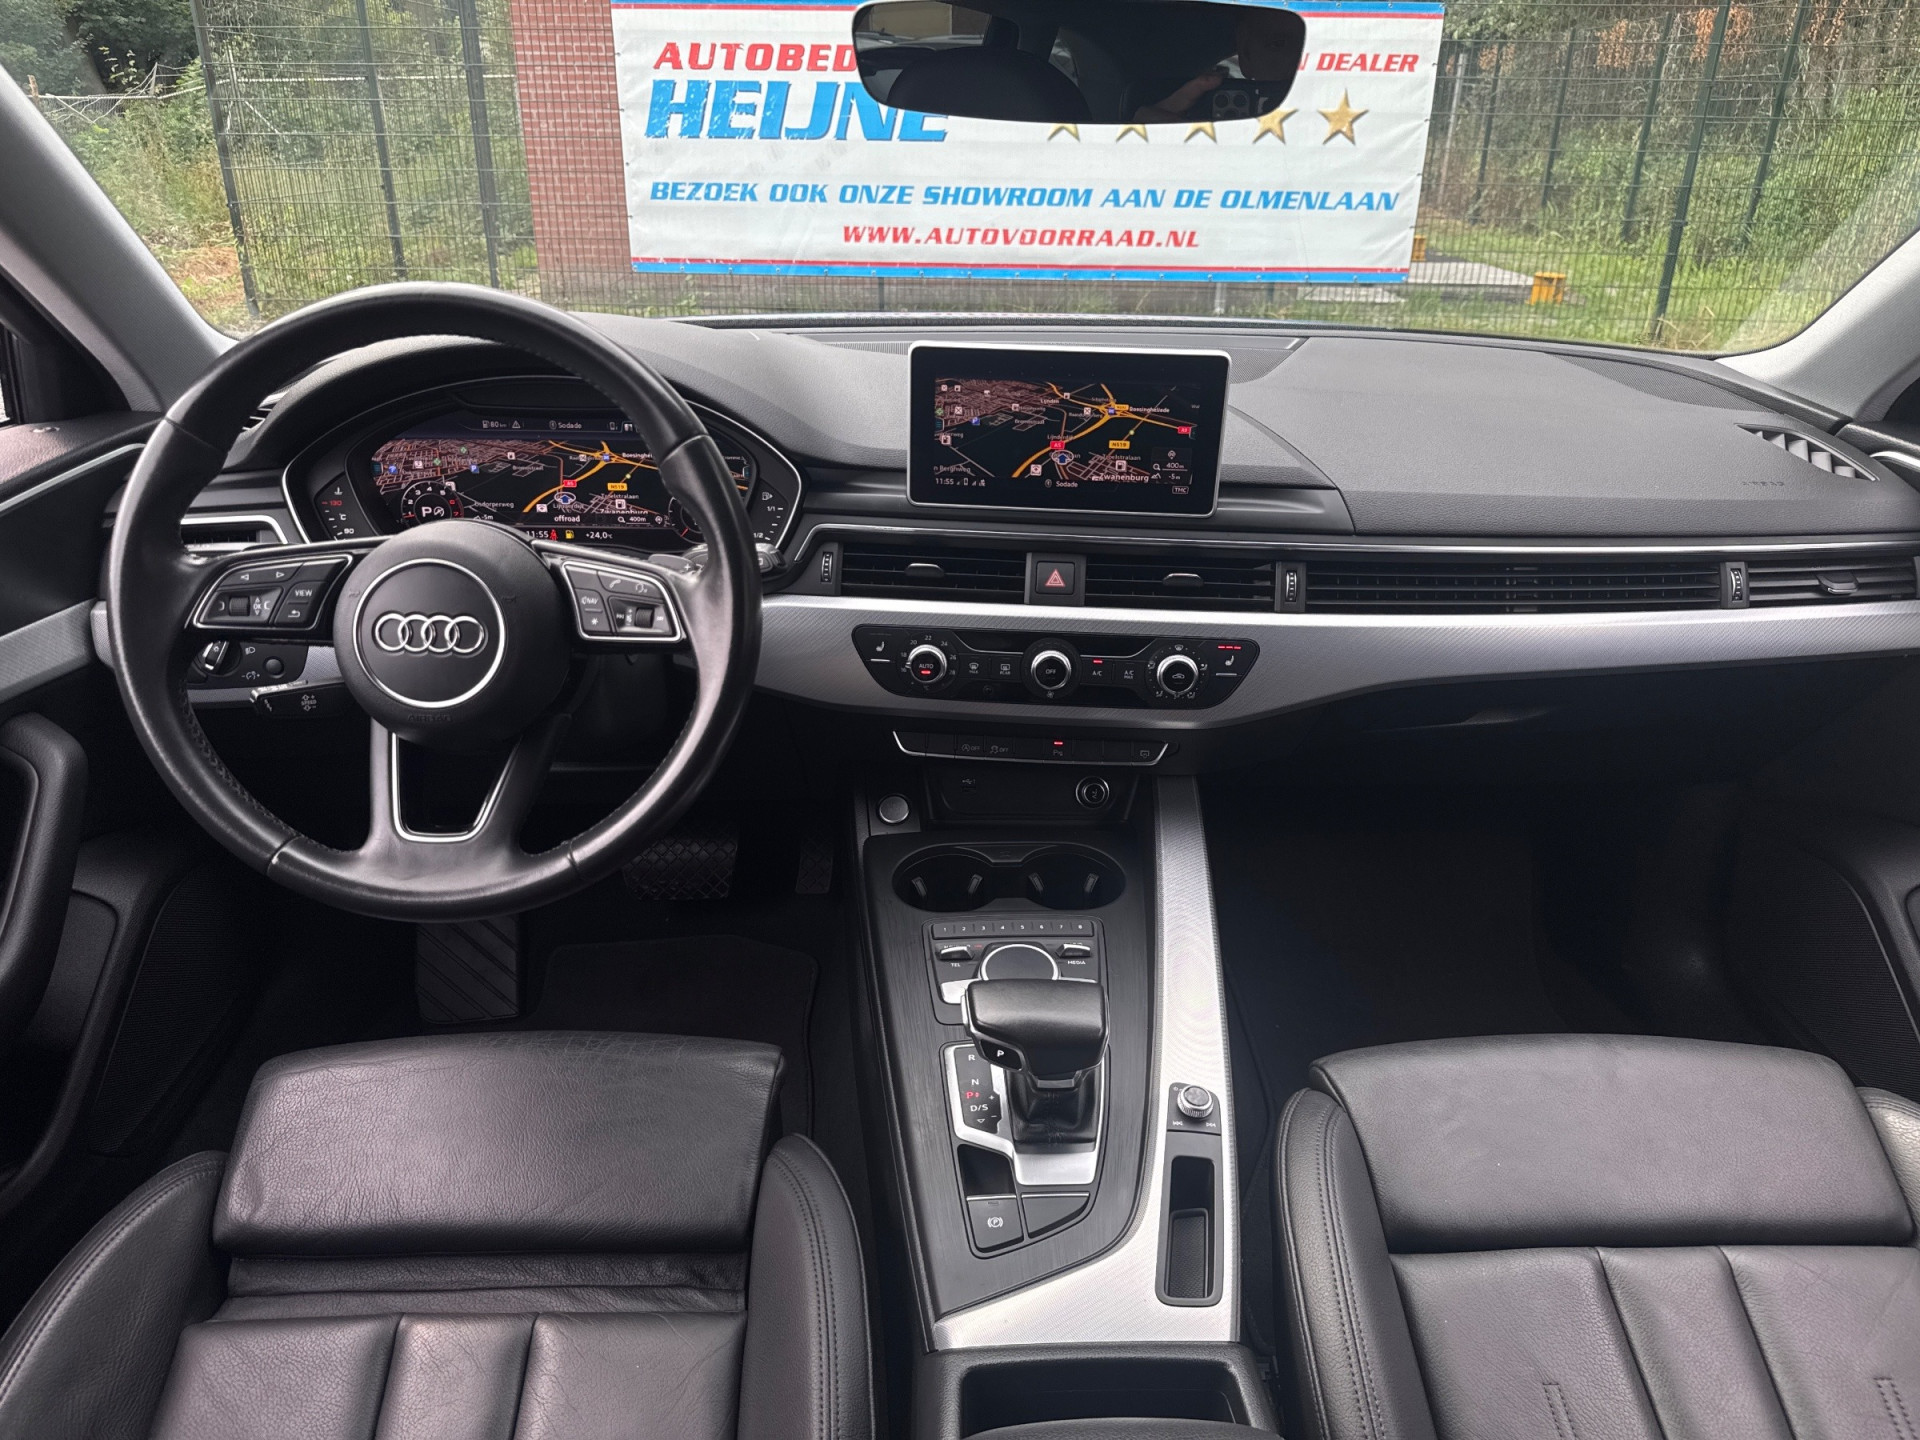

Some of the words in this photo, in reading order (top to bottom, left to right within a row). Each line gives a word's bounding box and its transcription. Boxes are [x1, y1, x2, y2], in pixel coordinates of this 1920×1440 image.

[653, 42, 857, 72] AUTOBED
[1316, 53, 1420, 73] DEALER
[644, 79, 949, 142] HEIJNE
[650, 182, 759, 202] BEZOEK
[769, 184, 829, 203] OOK
[839, 185, 913, 204] ONZE
[923, 186, 1094, 208] SHOWROOM
[1100, 189, 1166, 209] AAN
[1173, 190, 1212, 209] DE
[1220, 191, 1400, 211] OLMENLAAN
[843, 225, 1200, 248] WWW.AUTOVOORRAAD.NL
[935, 477, 954, 485] 11:55
[1099, 472, 1150, 483] Zwanenburg
[422, 506, 432, 518] P
[554, 515, 581, 523] offroad
[295, 589, 313, 597] VIEW
[253, 602, 262, 610] OK
[970, 1104, 989, 1112] D/S
